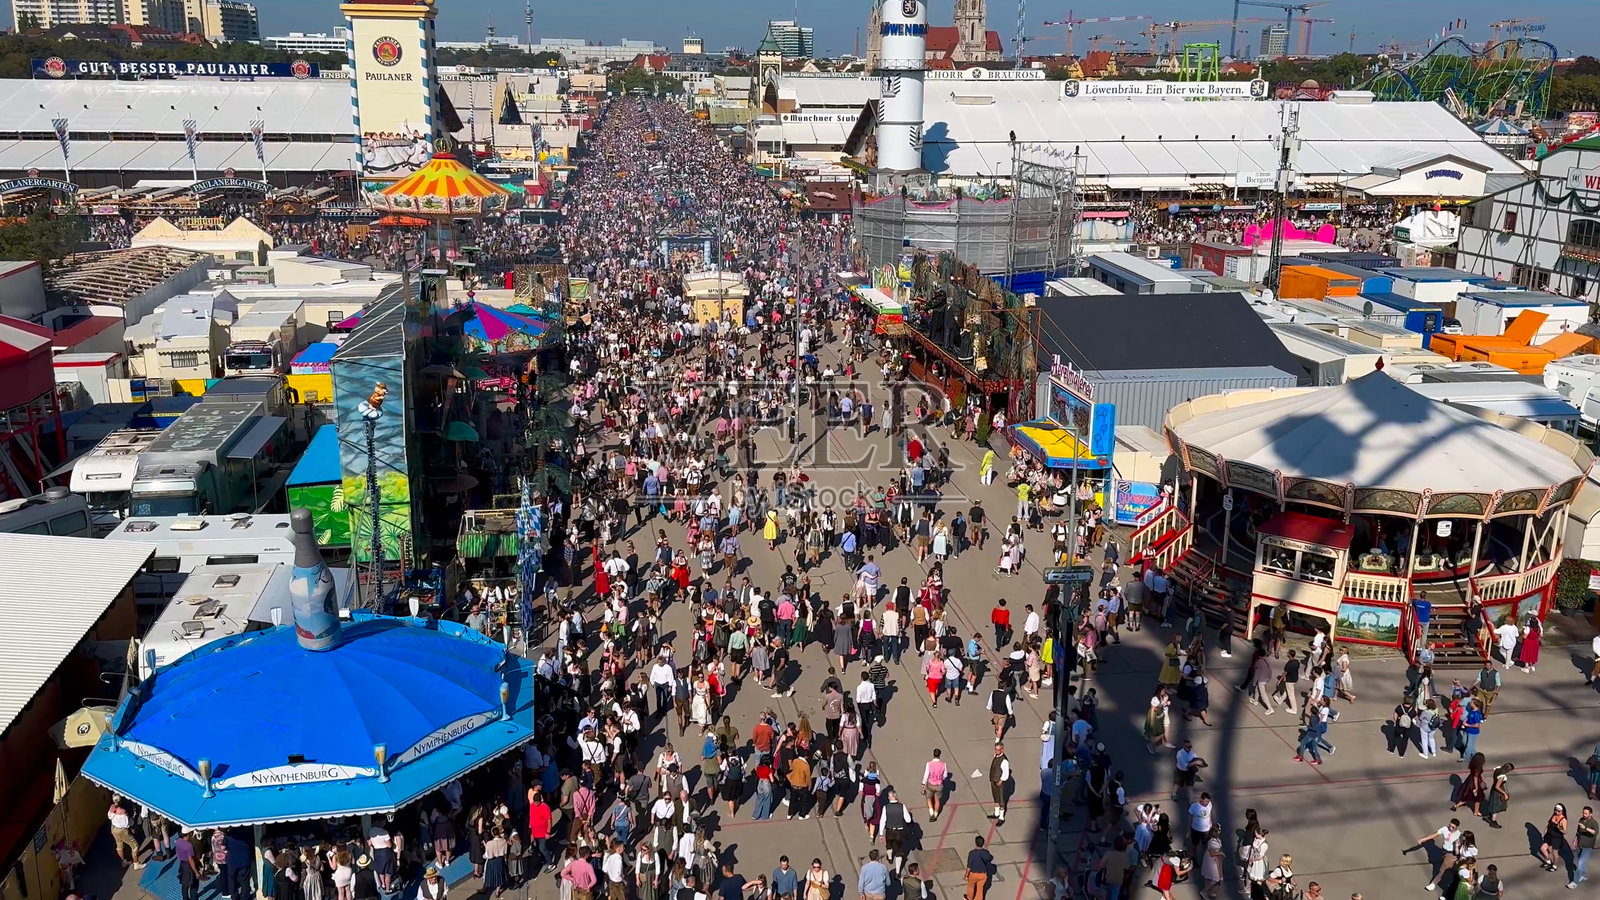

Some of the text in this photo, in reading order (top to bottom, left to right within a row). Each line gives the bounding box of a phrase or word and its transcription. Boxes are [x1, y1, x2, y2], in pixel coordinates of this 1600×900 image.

[80, 62, 275, 75] GUT, BESSER, PAULANER.
[365, 72, 413, 81] PAULANER
[1085, 84, 1244, 97] Löwenbräu. Ein Bier wie Bayern.
[0, 179, 75, 192] AULANERGARTEN
[193, 179, 269, 193] PAULANERGARTEN
[413, 718, 475, 756] NYMPHENBURG
[252, 767, 338, 784] NYMPHENBURG
